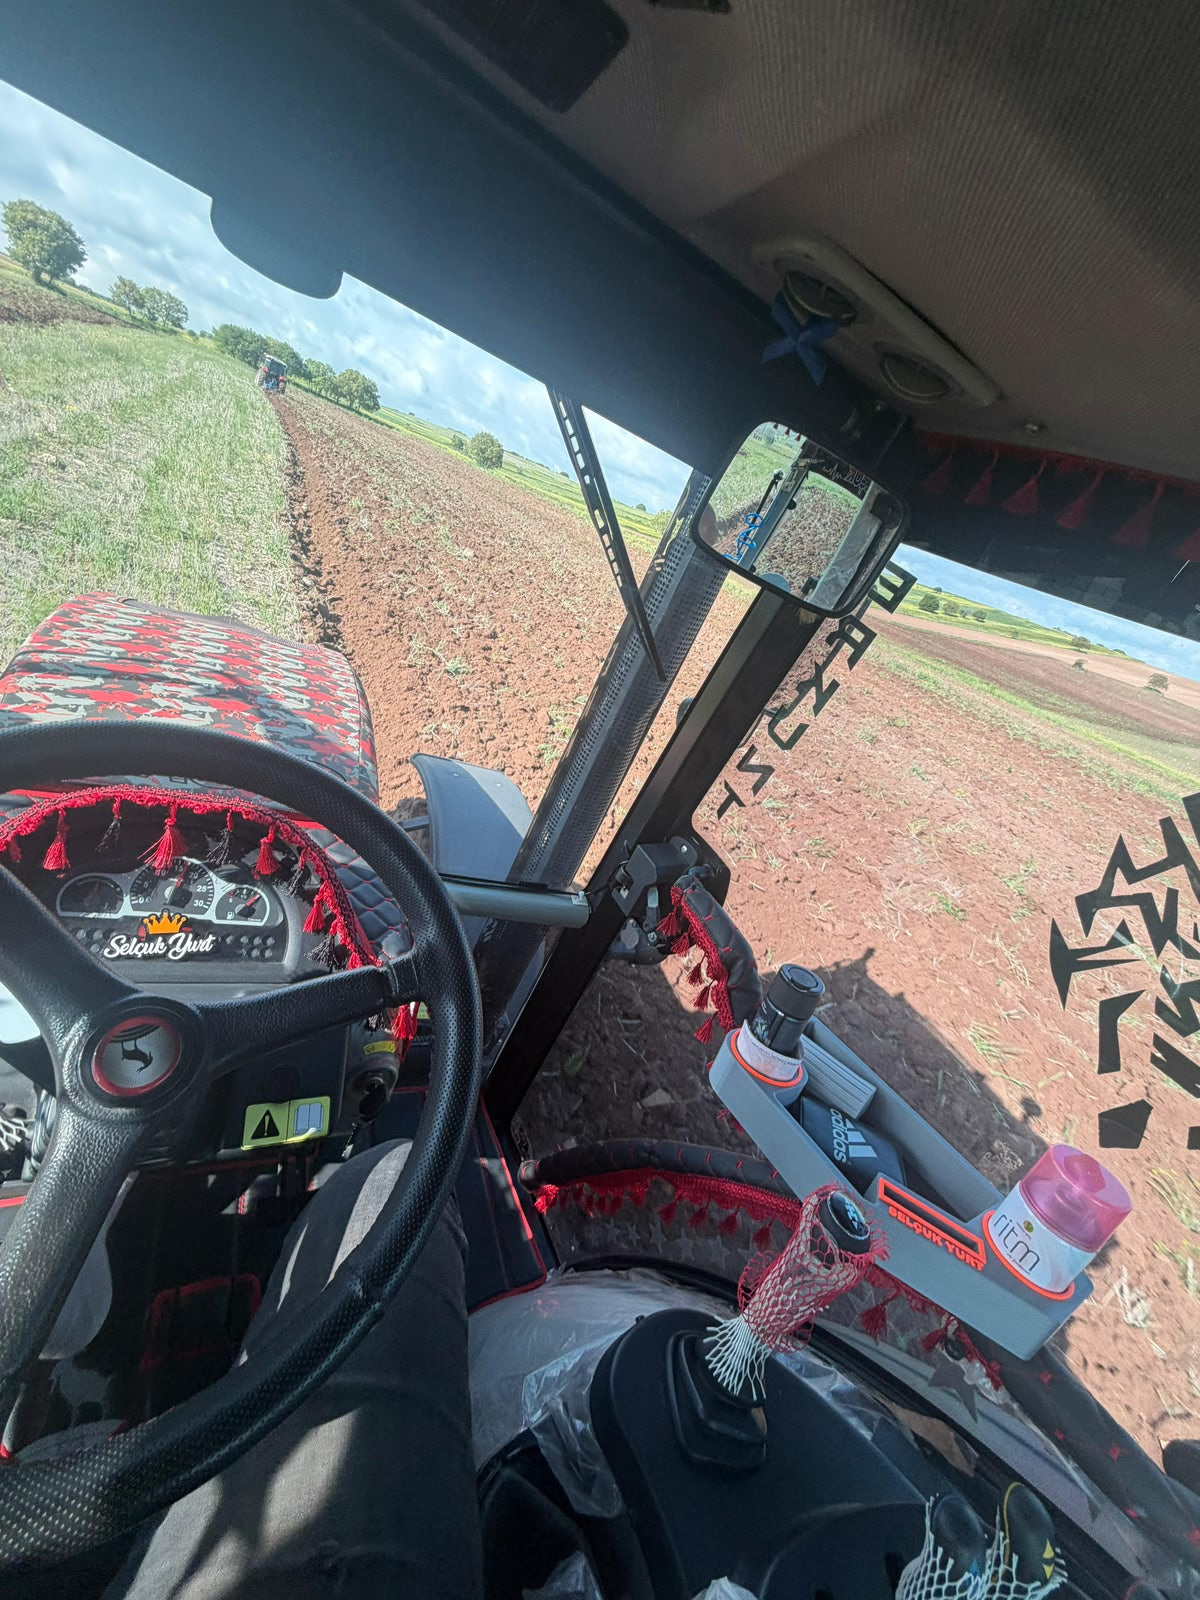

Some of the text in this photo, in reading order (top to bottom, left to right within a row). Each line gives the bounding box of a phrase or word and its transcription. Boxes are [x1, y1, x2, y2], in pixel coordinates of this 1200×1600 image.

[189, 871, 199, 879] 20
[196, 885, 207, 893] 25
[193, 899, 204, 907] 30
[103, 932, 217, 961] Selçuk Yurt
[830, 1108, 850, 1164] adidas
[888, 1205, 944, 1248] SELÇUK
[944, 1240, 986, 1273] YURT
[993, 1214, 1041, 1272] ritm
